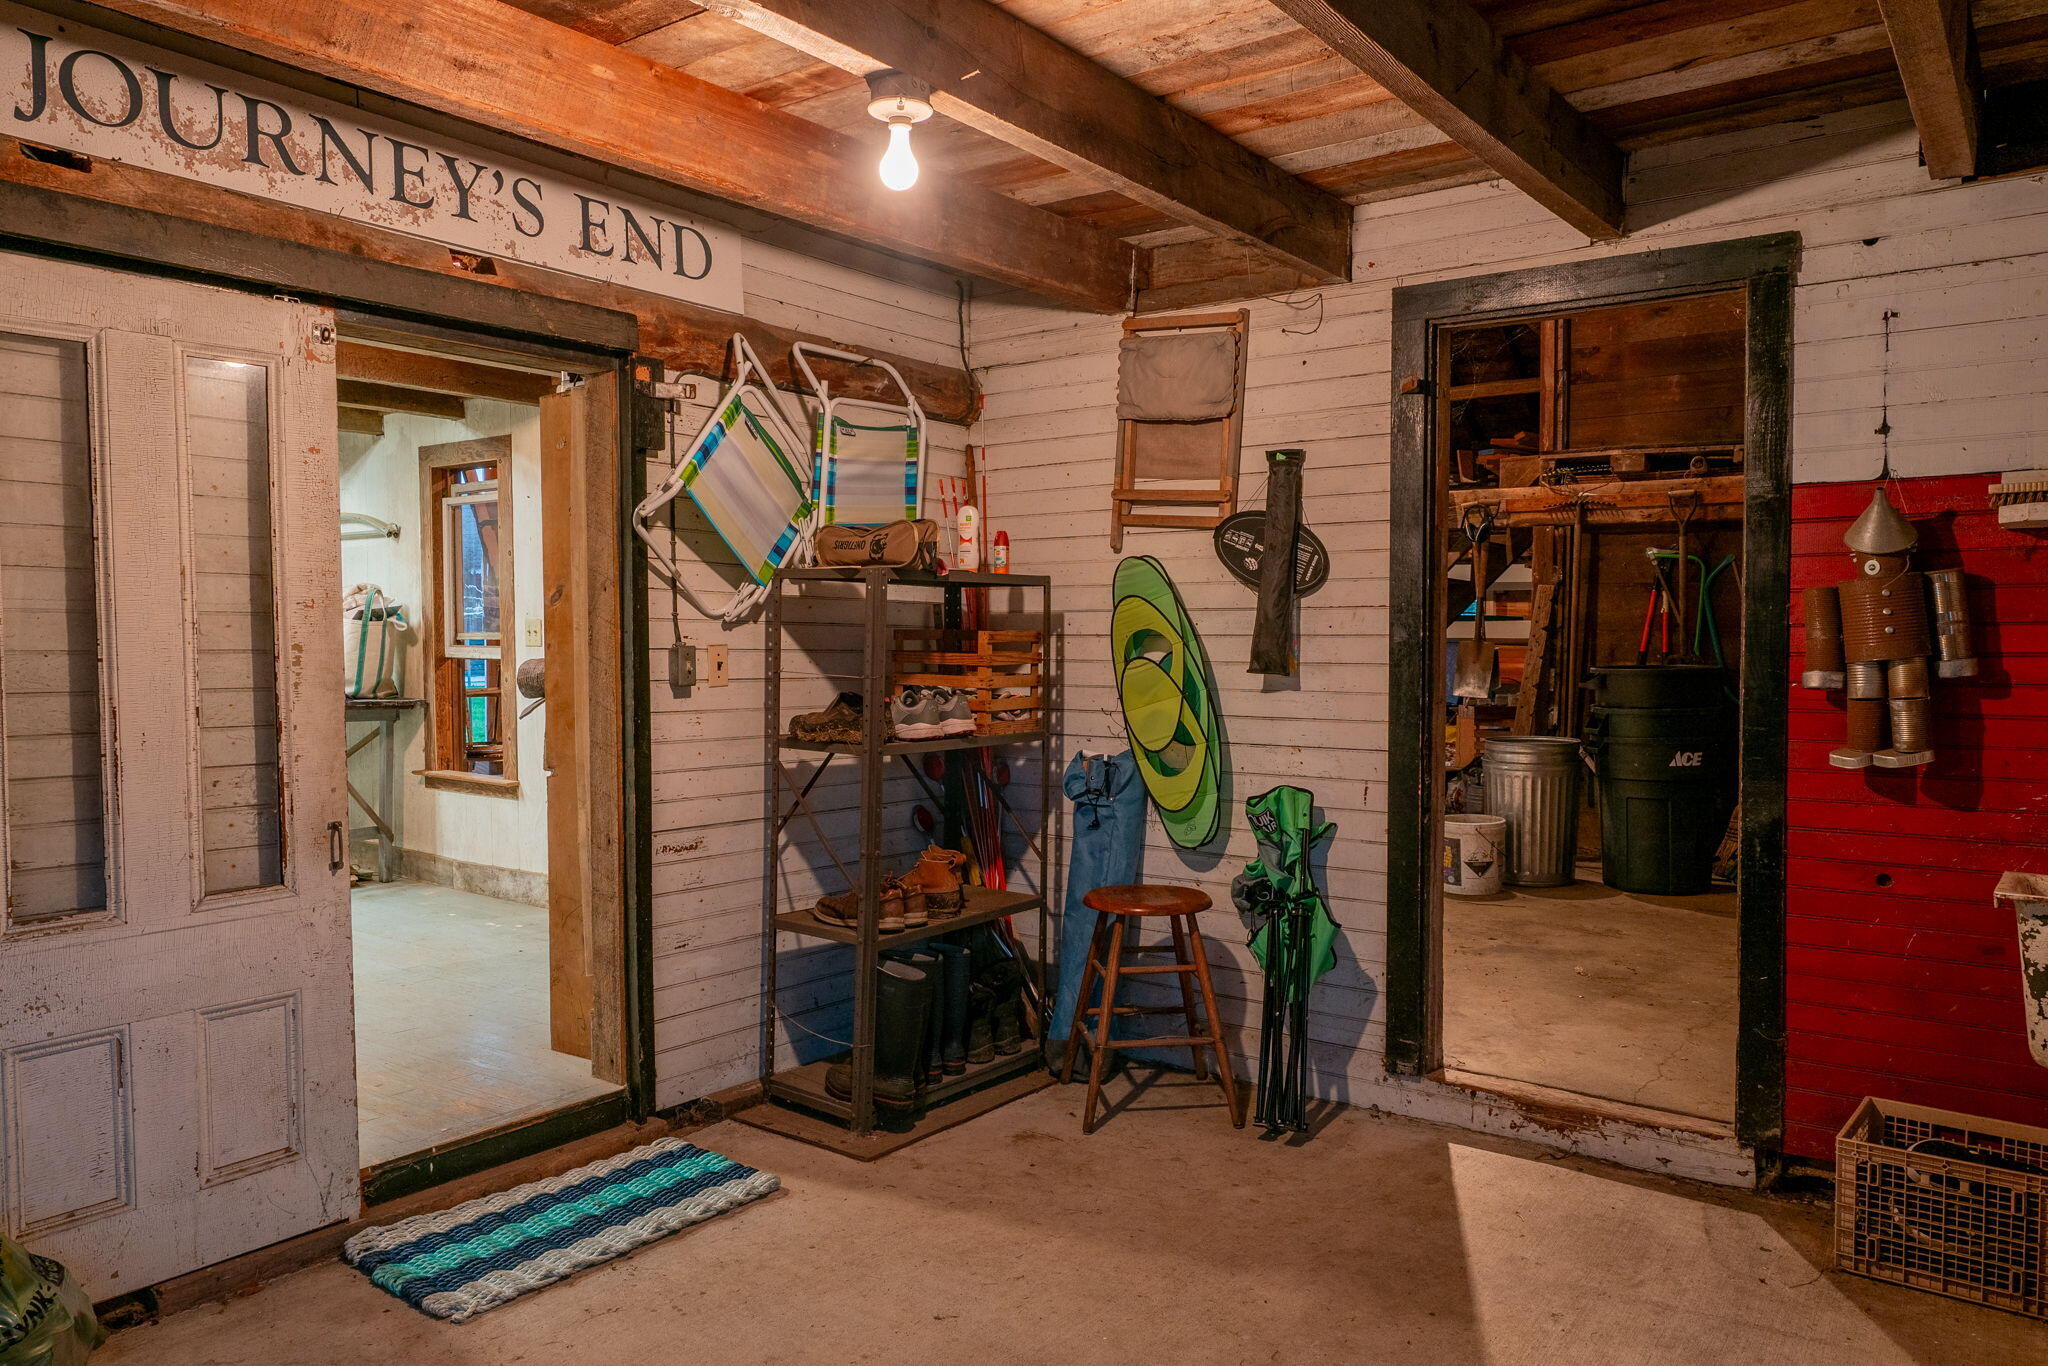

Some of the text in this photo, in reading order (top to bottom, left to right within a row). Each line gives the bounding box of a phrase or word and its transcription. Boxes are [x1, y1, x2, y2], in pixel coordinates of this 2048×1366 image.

[14, 27, 713, 280] JOURNEY'S END
[1669, 750, 1703, 767] ACE
